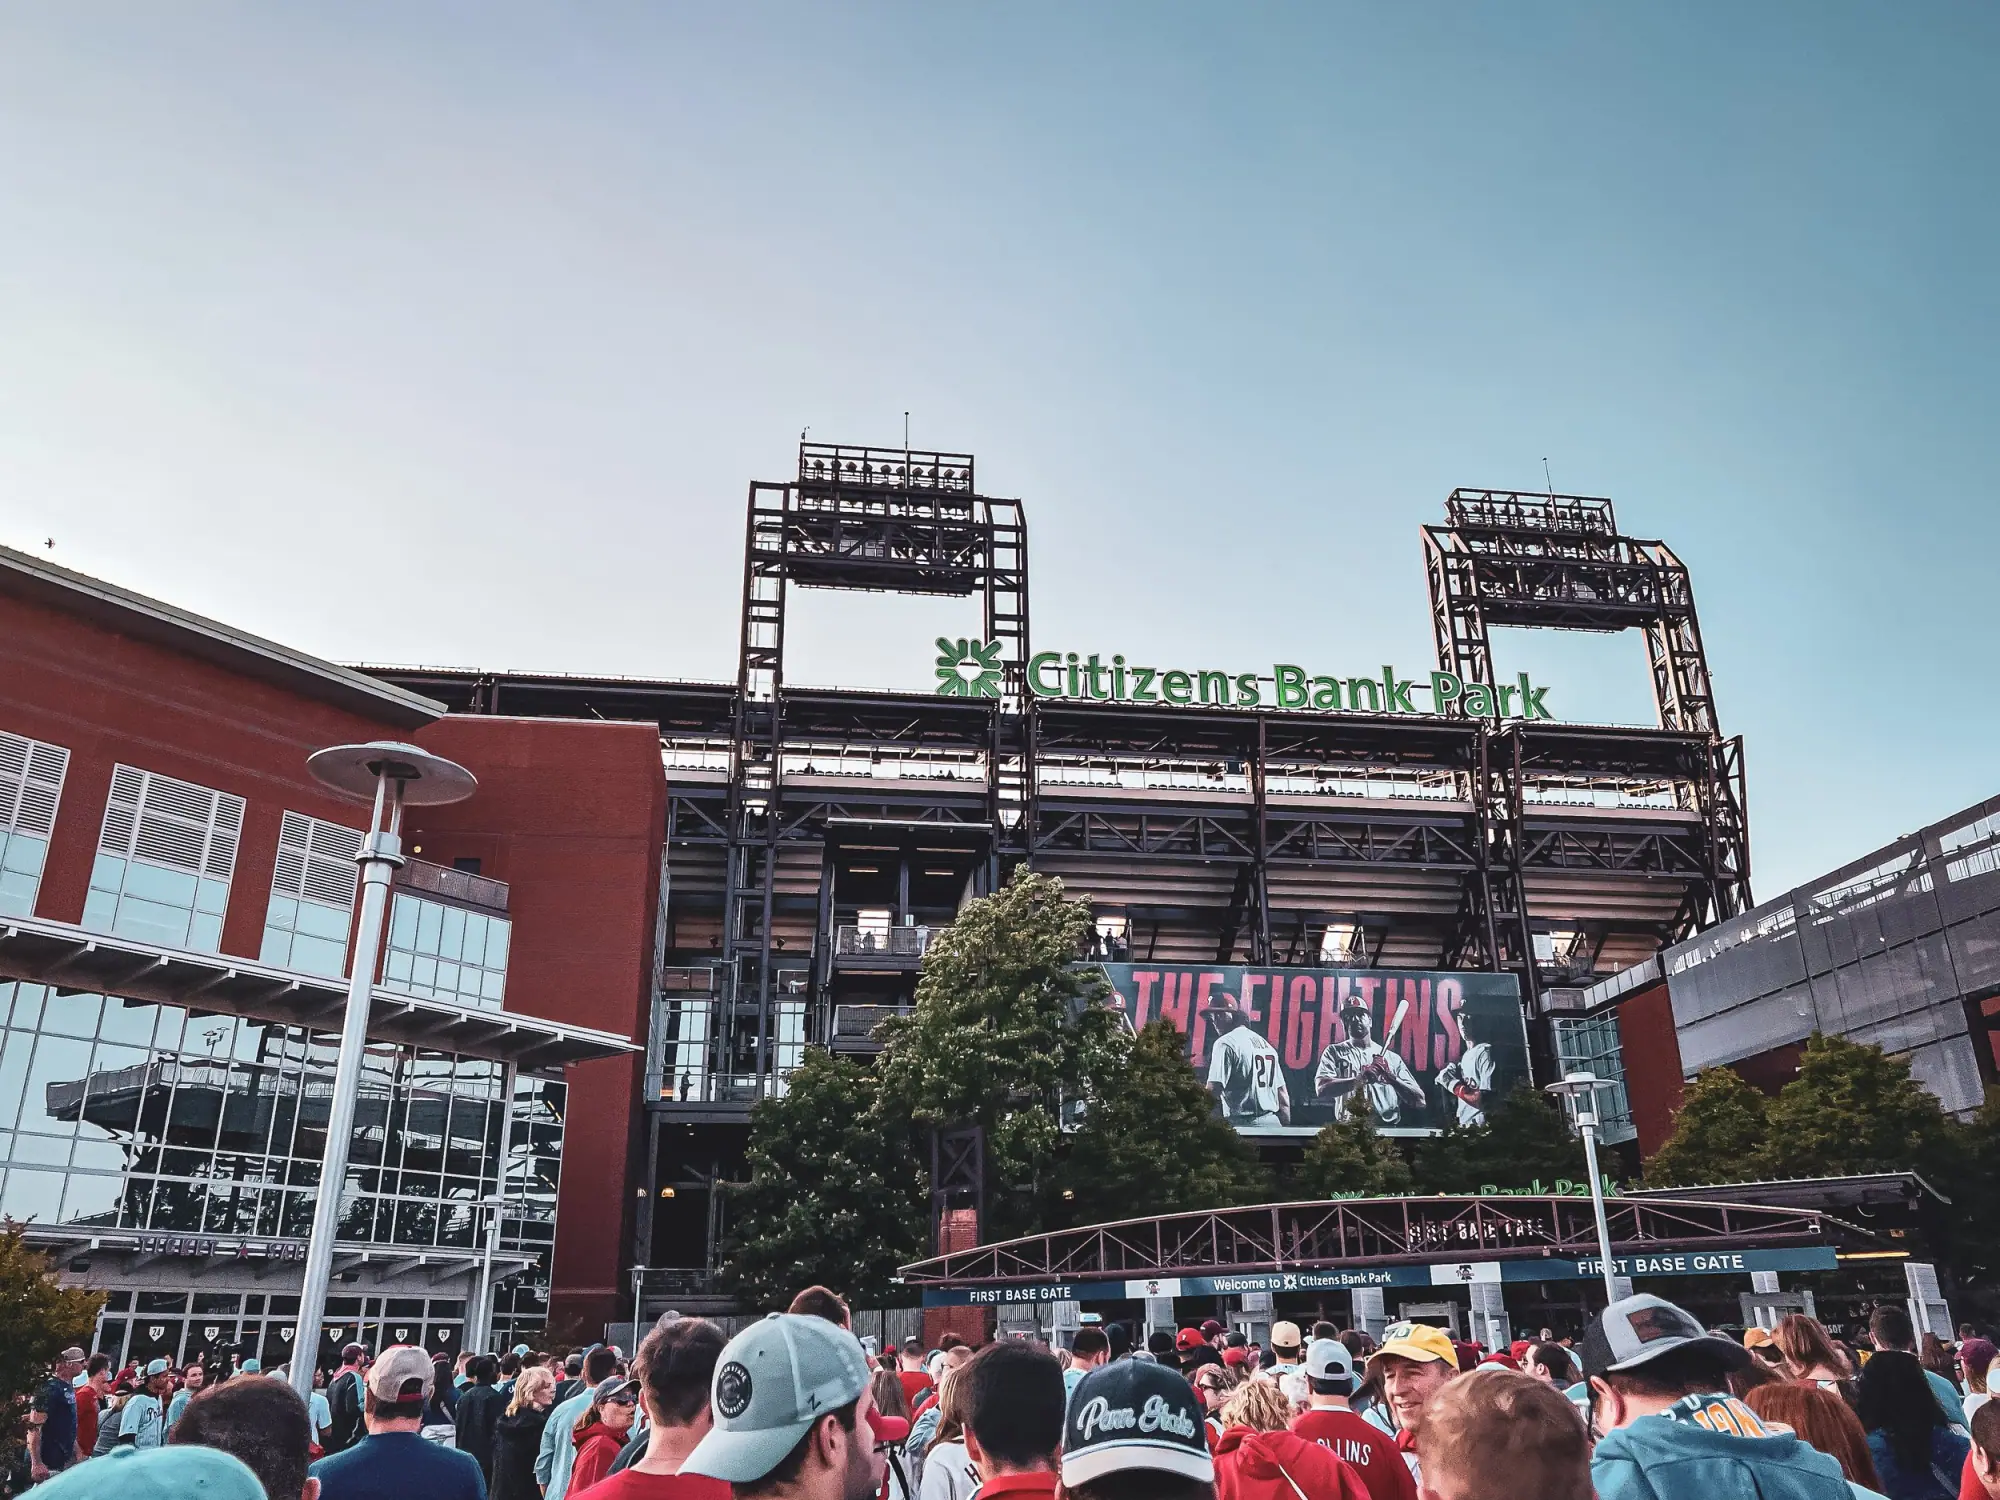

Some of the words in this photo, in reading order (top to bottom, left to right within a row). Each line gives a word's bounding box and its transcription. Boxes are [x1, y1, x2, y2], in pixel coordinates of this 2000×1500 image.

[1027, 651, 1261, 708] Citizens
[1273, 664, 1419, 713] Bank
[1430, 670, 1556, 720] Park
[1254, 1054, 1276, 1087] 27
[1555, 1174, 1619, 1197] Pak
[1635, 1257, 1687, 1273] BASE
[1693, 1254, 1745, 1270] GATE
[1213, 1279, 1266, 1291] Welcome
[1269, 1278, 1281, 1289] to
[1299, 1274, 1340, 1287] Citizens
[1341, 1273, 1367, 1285] Bank
[1368, 1271, 1392, 1283] Park
[970, 1290, 1002, 1302] FIRST
[1005, 1288, 1036, 1301] BASE
[1040, 1286, 1072, 1299] GATE
[152, 1327, 161, 1337] 24
[206, 1327, 216, 1337] 25
[283, 1329, 292, 1338] 26
[331, 1329, 341, 1339] 27
[1077, 1396, 1136, 1440] Penn
[1139, 1395, 1195, 1439] State
